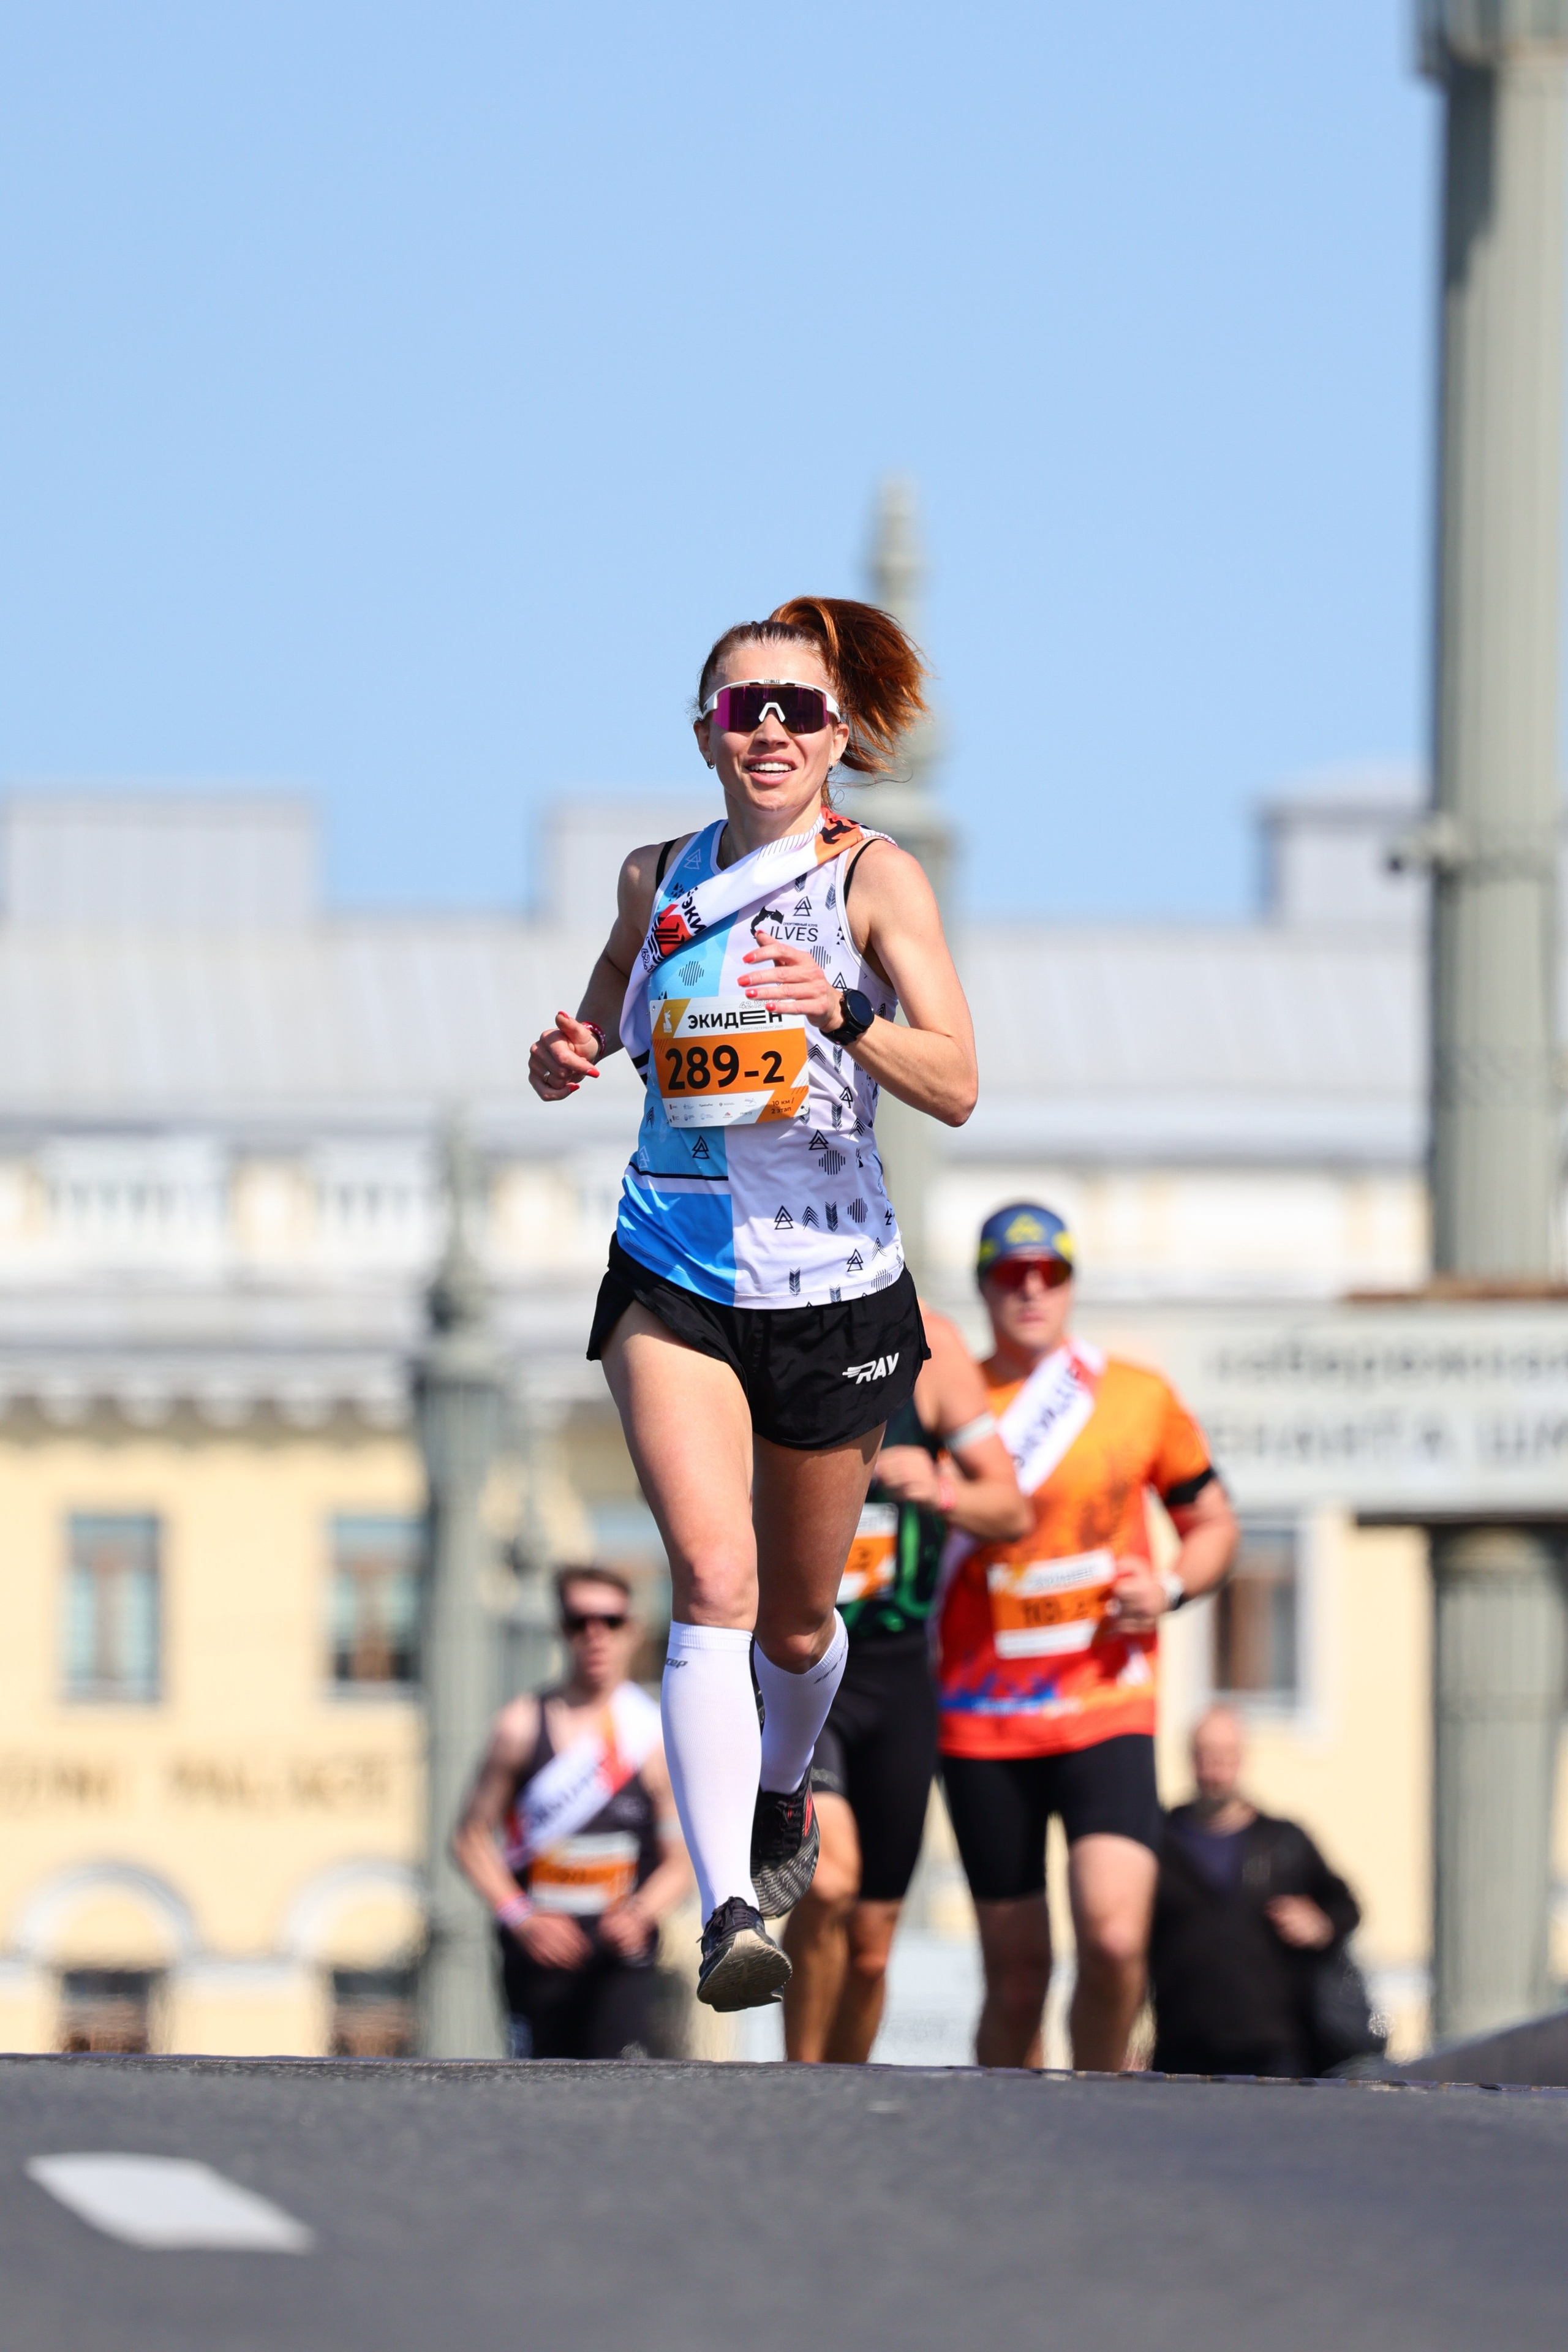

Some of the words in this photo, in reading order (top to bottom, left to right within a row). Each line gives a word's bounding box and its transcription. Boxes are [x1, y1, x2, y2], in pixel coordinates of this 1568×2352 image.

[770, 925, 819, 942] ILVES
[687, 1009, 783, 1030] ЭКИДЕН
[665, 1044, 785, 1090] 289-2
[842, 1352, 900, 1385] RAY
